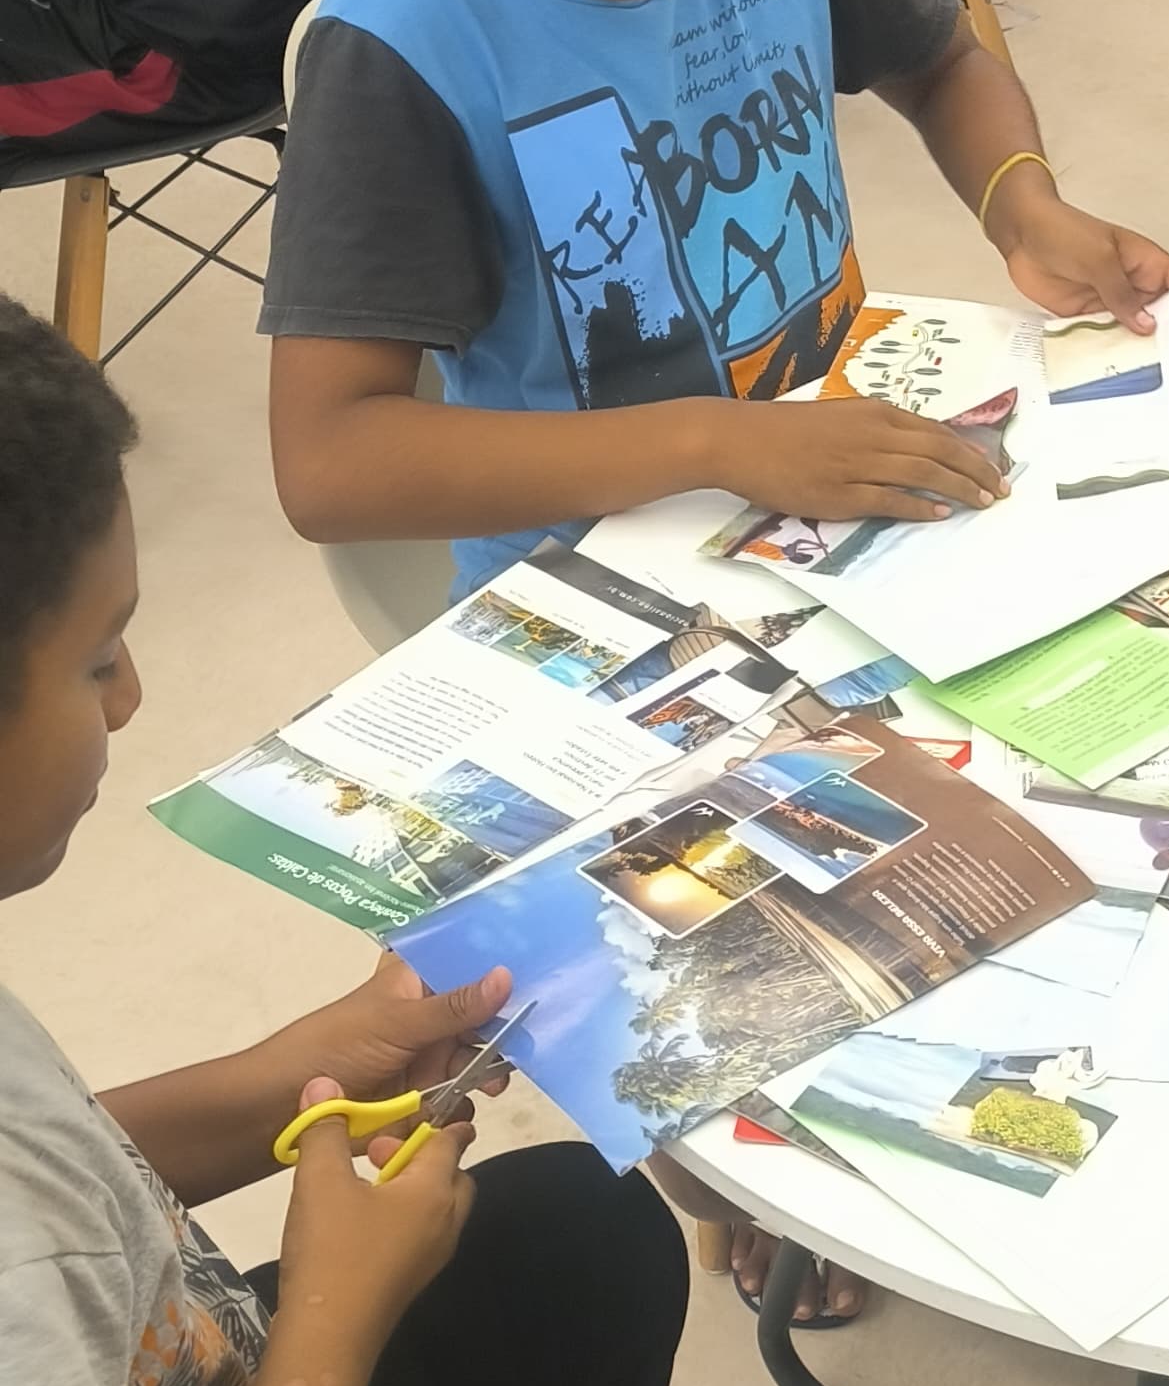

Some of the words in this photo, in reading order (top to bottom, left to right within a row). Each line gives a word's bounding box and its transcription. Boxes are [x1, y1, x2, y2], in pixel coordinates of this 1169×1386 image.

[320, 872, 363, 907] Poços
[900, 913, 927, 939] ESSA
[920, 932, 947, 959] VIVA
